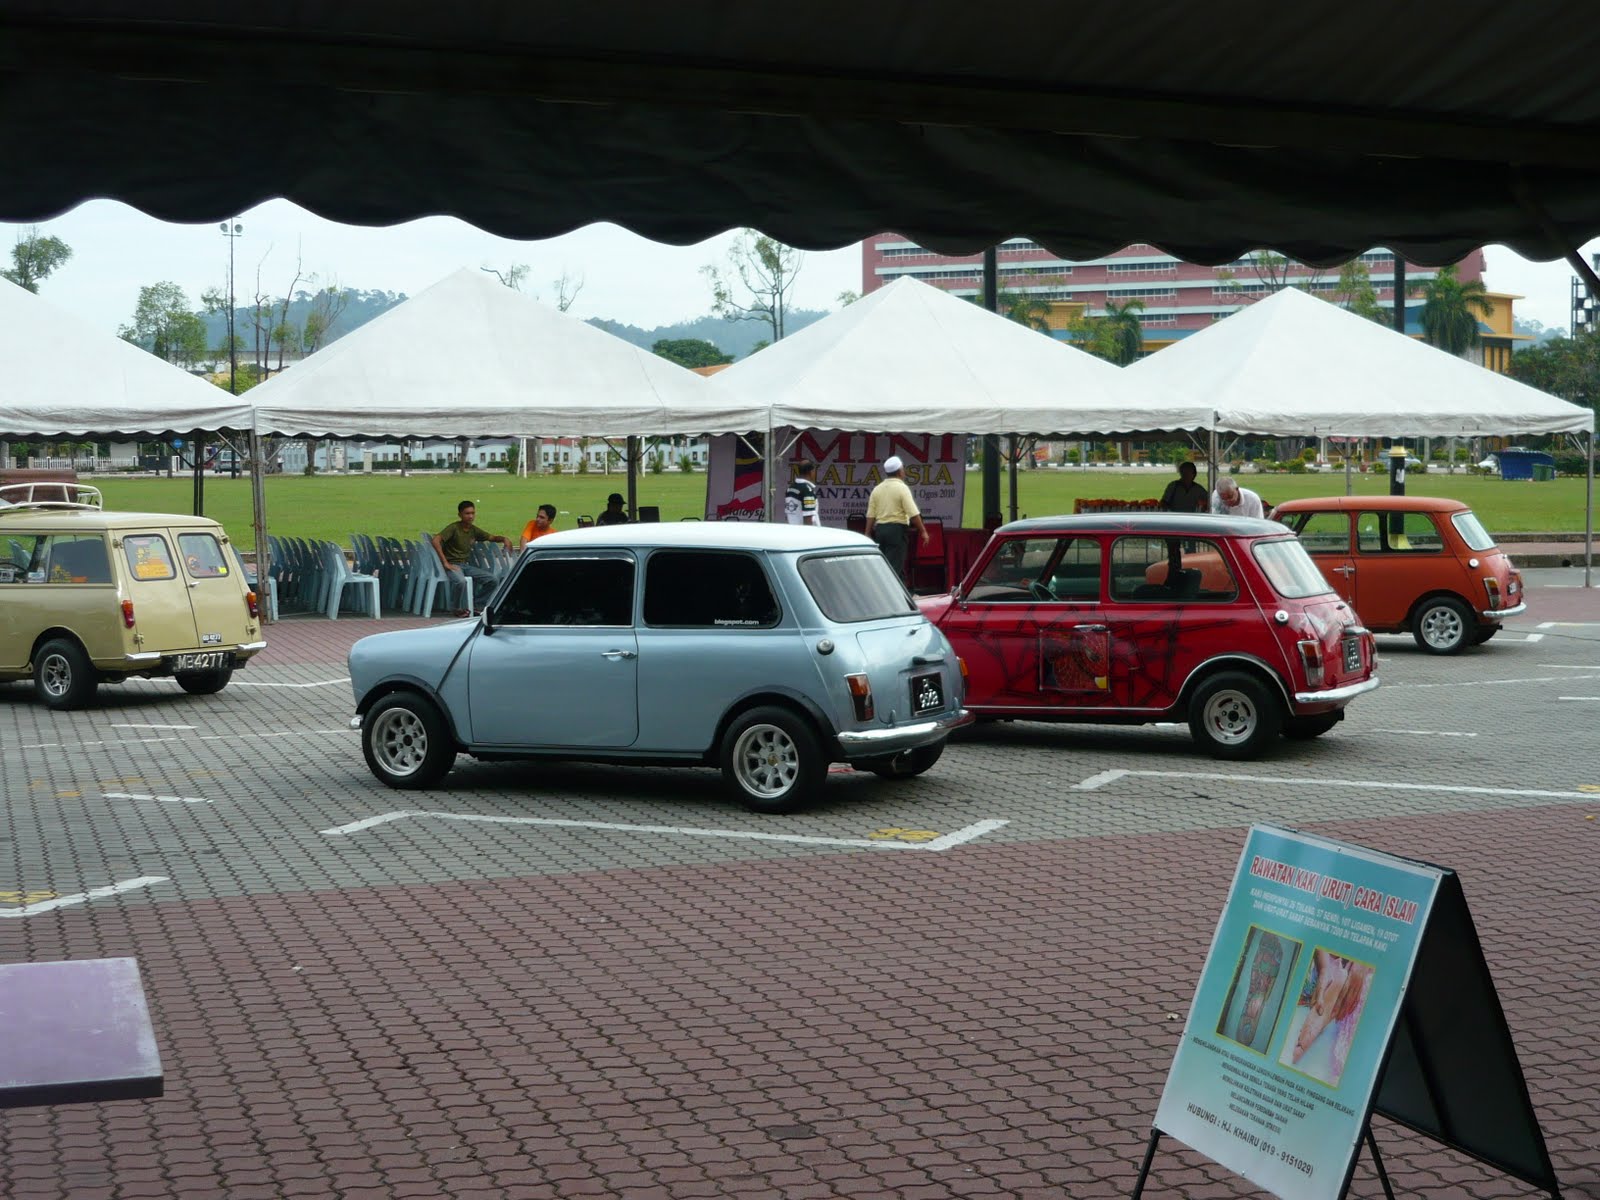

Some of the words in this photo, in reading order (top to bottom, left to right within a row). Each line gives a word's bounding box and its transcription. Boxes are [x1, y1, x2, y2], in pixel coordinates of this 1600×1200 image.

[789, 431, 958, 463] MINI
[788, 464, 954, 486] MALASIA
[939, 488, 956, 498] 2010
[722, 505, 766, 520] Malaysi
[714, 618, 760, 627] blogspot.com
[1250, 855, 1295, 885] RAWATAN
[1292, 868, 1319, 893] KAKI
[1315, 875, 1354, 909] (URUT)
[1353, 886, 1384, 913] CARA
[1382, 894, 1417, 924] ISLAM
[1187, 1103, 1216, 1124] HUBUNGI
[1221, 1120, 1232, 1132] HJ.
[1233, 1126, 1259, 1146] KHAIRU
[1260, 1140, 1275, 1155] (019
[1280, 1150, 1313, 1175] 9151029)
